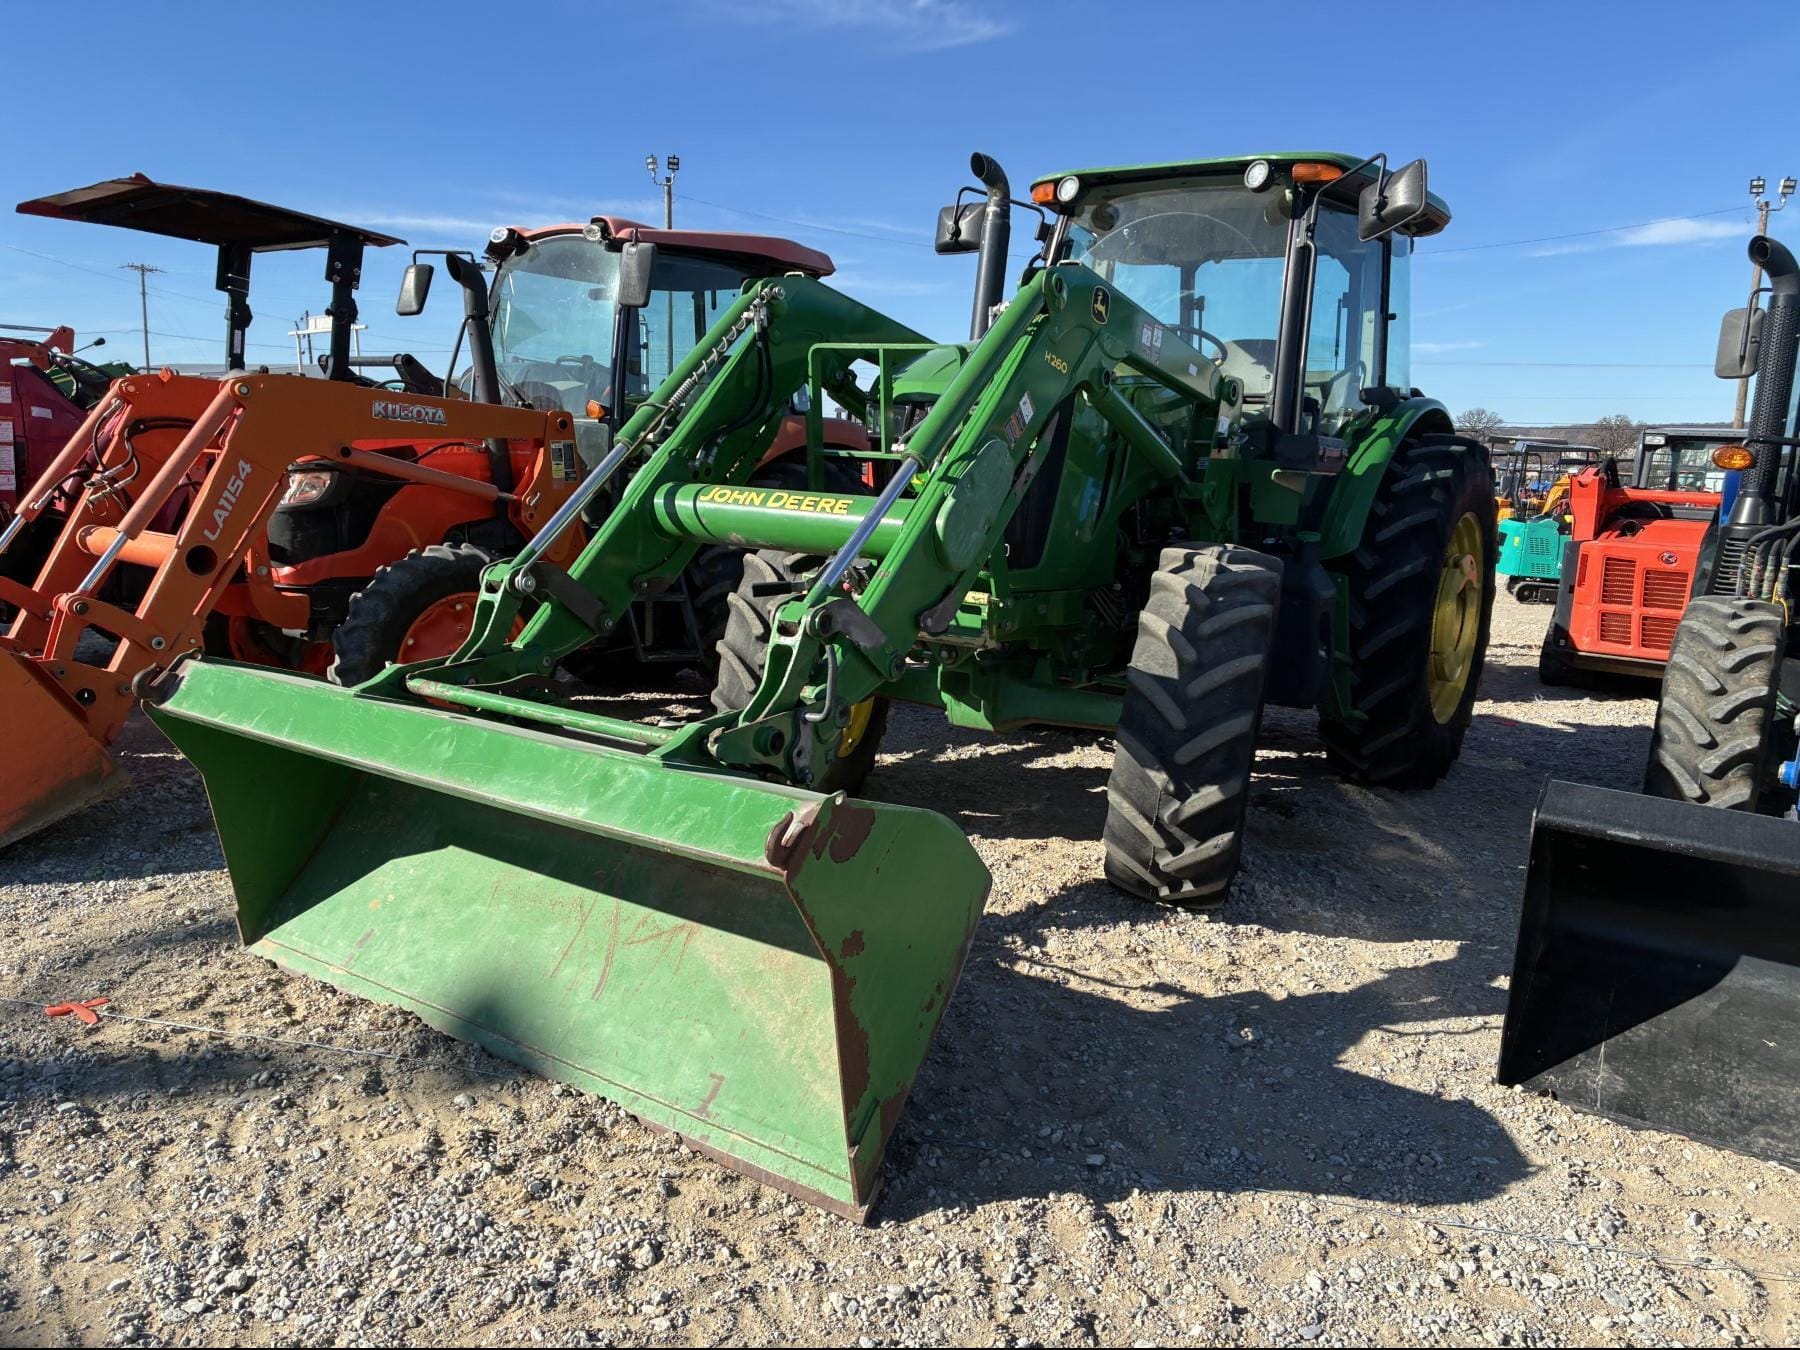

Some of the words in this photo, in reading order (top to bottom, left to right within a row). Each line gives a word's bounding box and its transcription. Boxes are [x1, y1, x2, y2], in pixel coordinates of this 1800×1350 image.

[1044, 350, 1068, 374] H260
[372, 400, 448, 426] KUBOTA
[203, 459, 252, 541] LA1154
[700, 487, 763, 506] JOHN
[766, 491, 854, 514] DEERE
